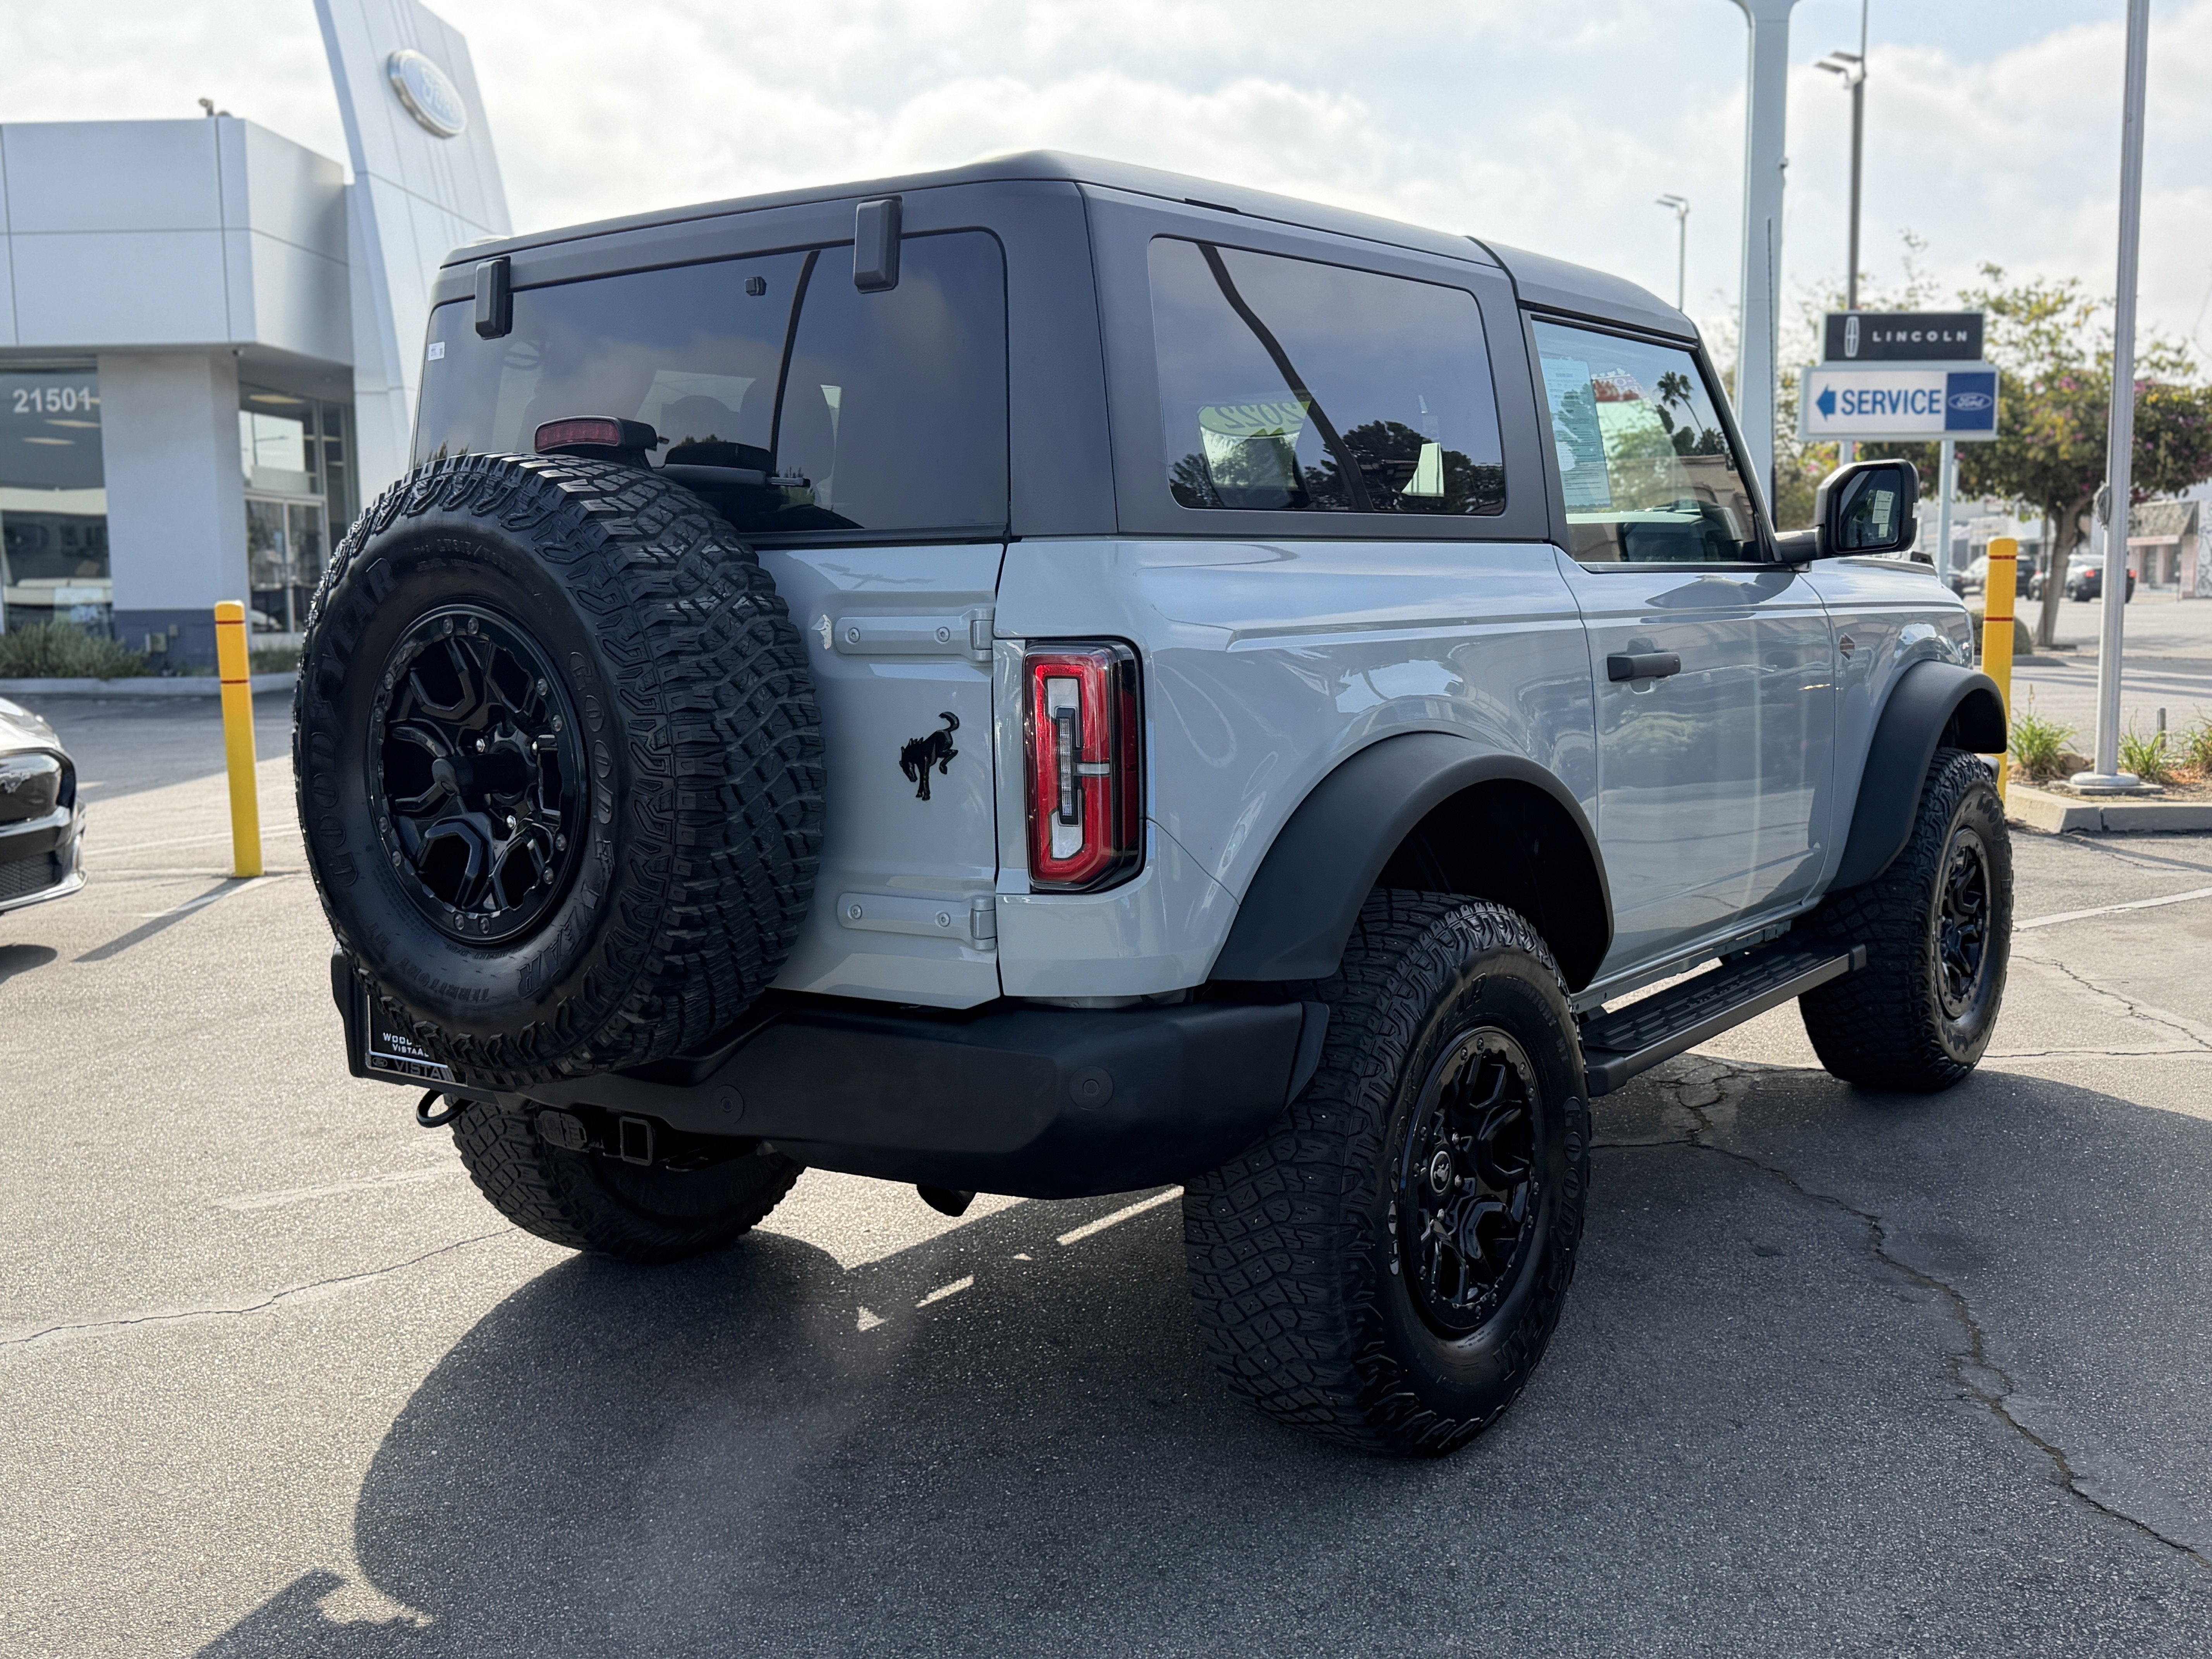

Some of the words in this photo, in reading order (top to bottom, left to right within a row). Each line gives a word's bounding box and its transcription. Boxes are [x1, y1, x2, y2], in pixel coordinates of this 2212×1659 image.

[1872, 330, 1968, 342] LINCOLN
[13, 386, 91, 413] 21501
[1841, 389, 1941, 415] SERVICE
[1956, 396, 1985, 408] Ford
[518, 651, 615, 1000] GOODYEAR
[400, 957, 489, 1004] TERRITORY
[394, 1059, 442, 1080] VISTA
